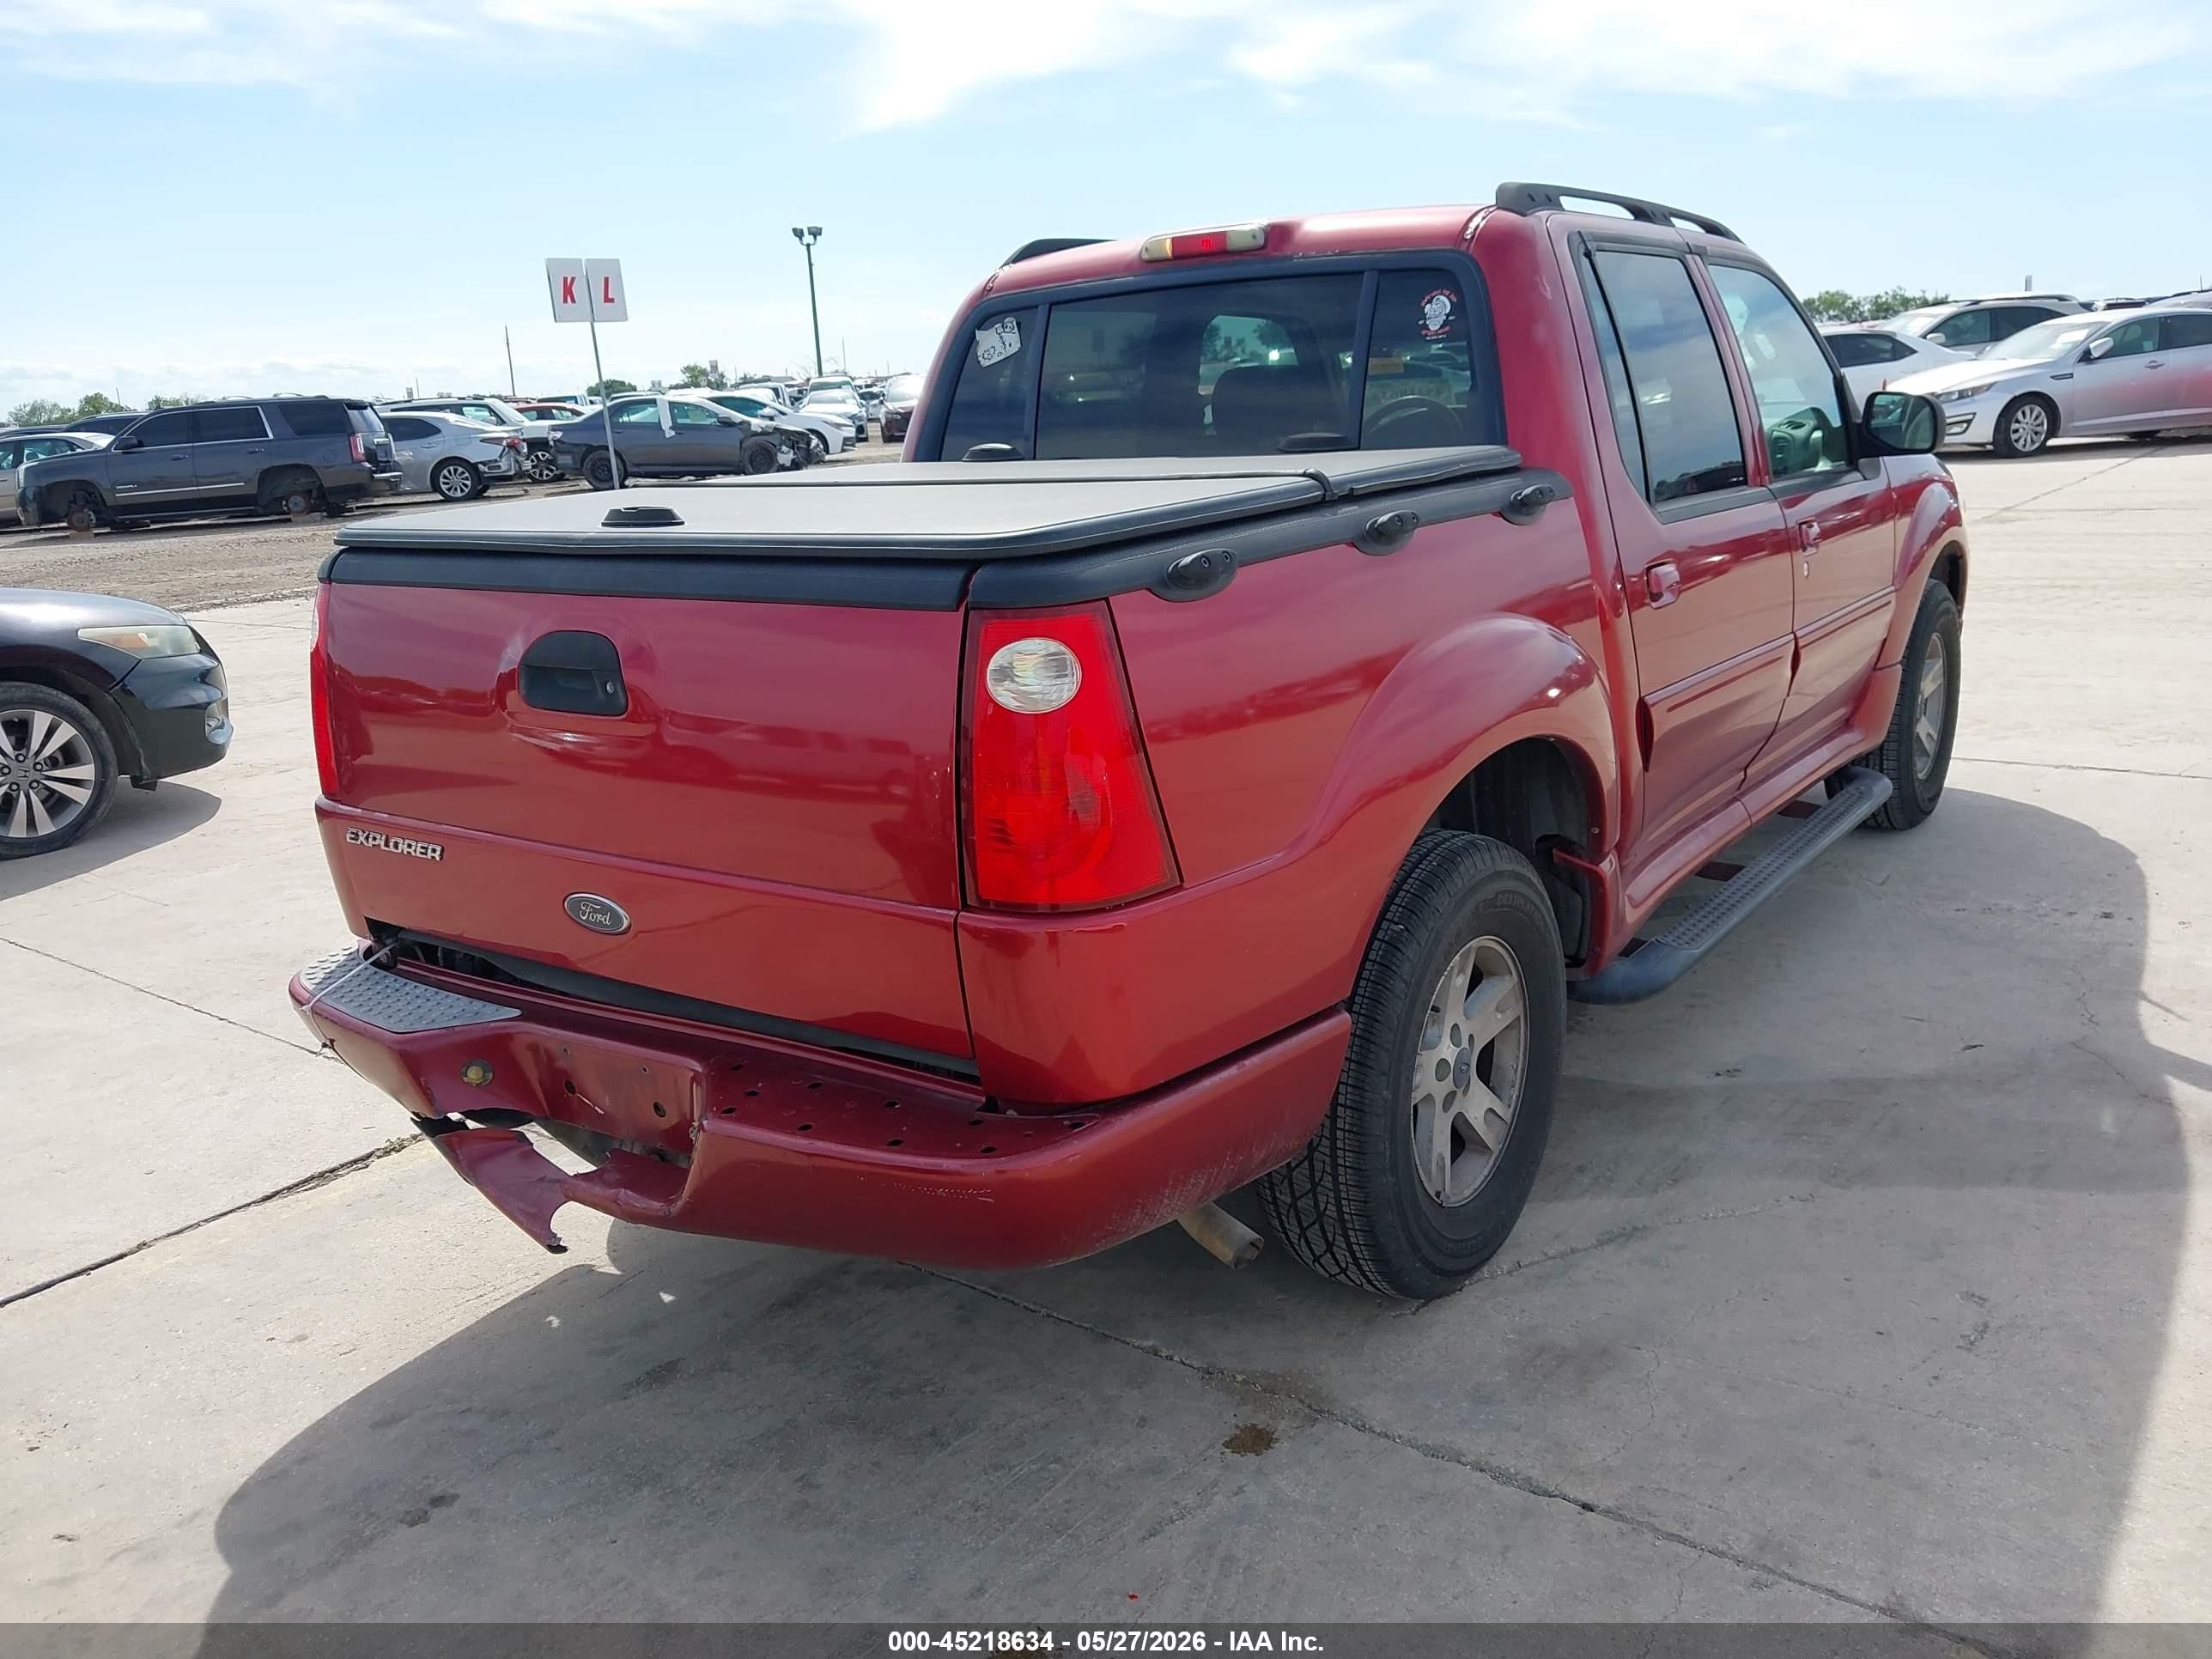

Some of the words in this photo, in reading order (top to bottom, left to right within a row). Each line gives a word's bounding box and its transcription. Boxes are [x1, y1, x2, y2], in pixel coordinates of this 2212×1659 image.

[562, 276, 577, 304] K
[603, 276, 616, 304] L
[345, 827, 444, 861] EXPLORER
[578, 899, 612, 926] Ford
